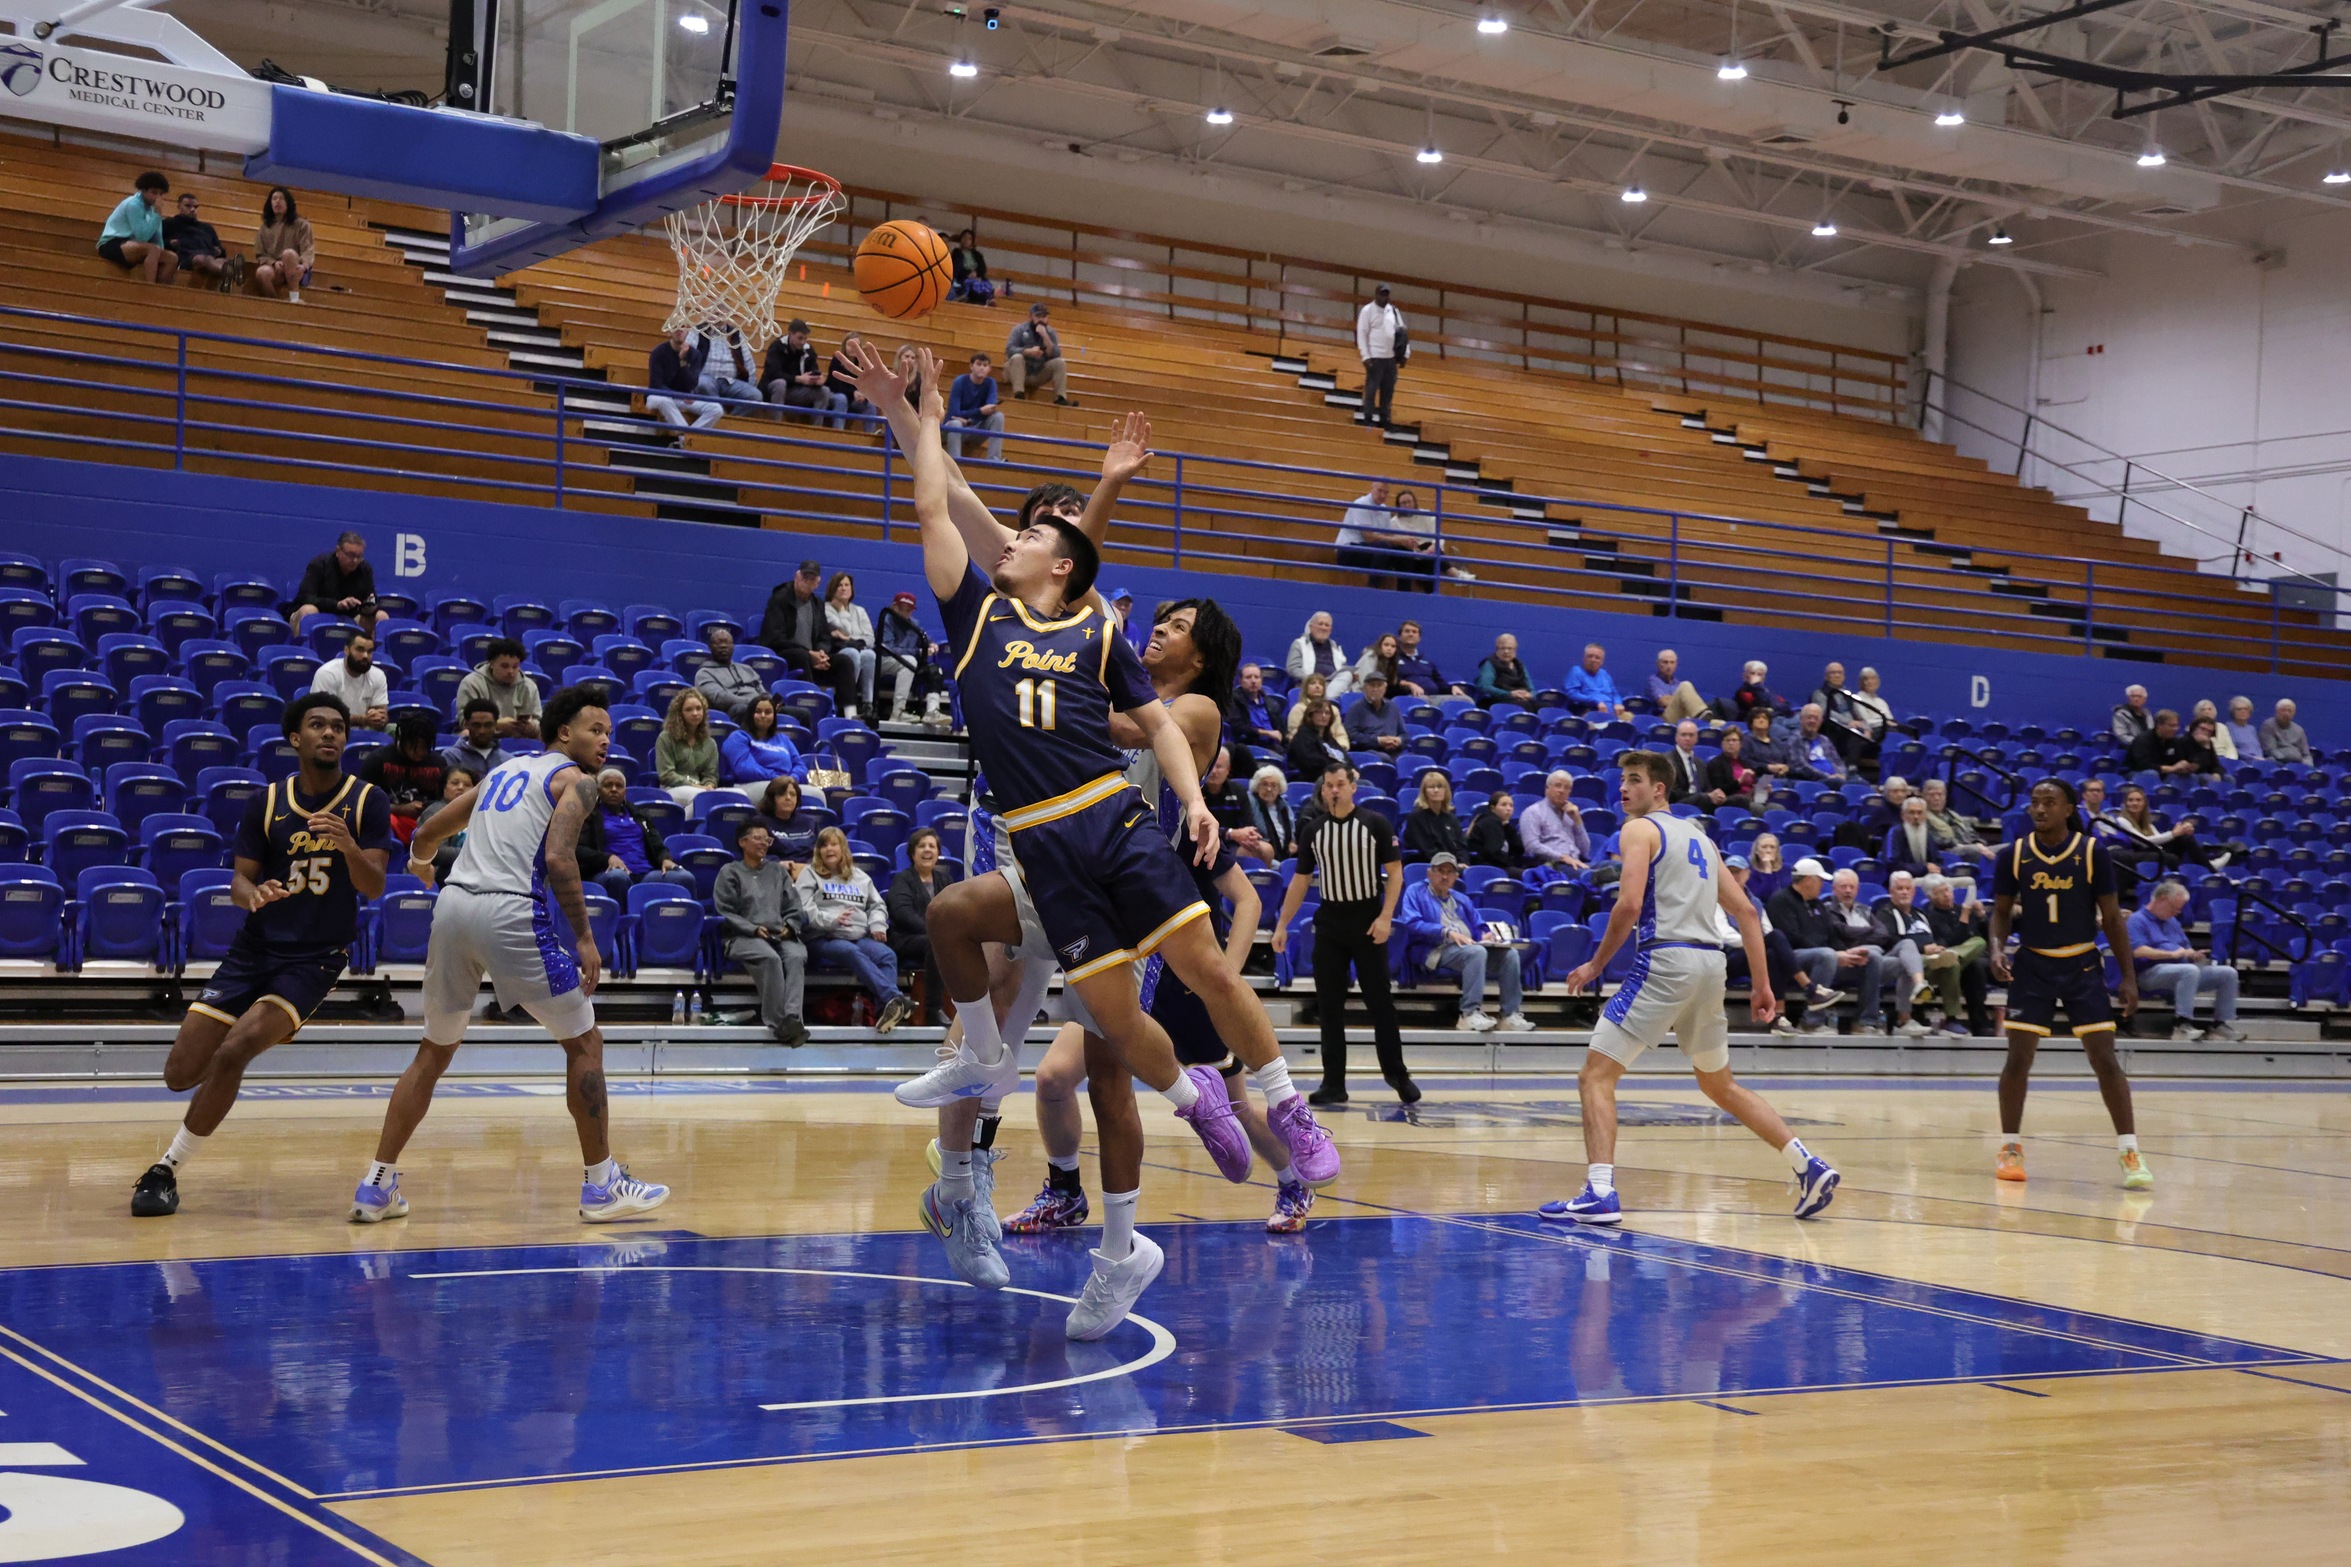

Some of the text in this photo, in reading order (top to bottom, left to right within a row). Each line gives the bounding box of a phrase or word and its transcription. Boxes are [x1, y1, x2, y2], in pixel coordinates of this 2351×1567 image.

[69, 88, 206, 122] MEDICAL CENTER
[394, 532, 427, 577] B
[997, 640, 1078, 674] Point
[1014, 677, 1056, 731] 11
[1970, 674, 1991, 708] D
[477, 770, 530, 813] 10
[286, 856, 333, 896] 55
[1687, 837, 1708, 880] 4
[2029, 871, 2074, 890] Point
[2046, 893, 2059, 923] 1
